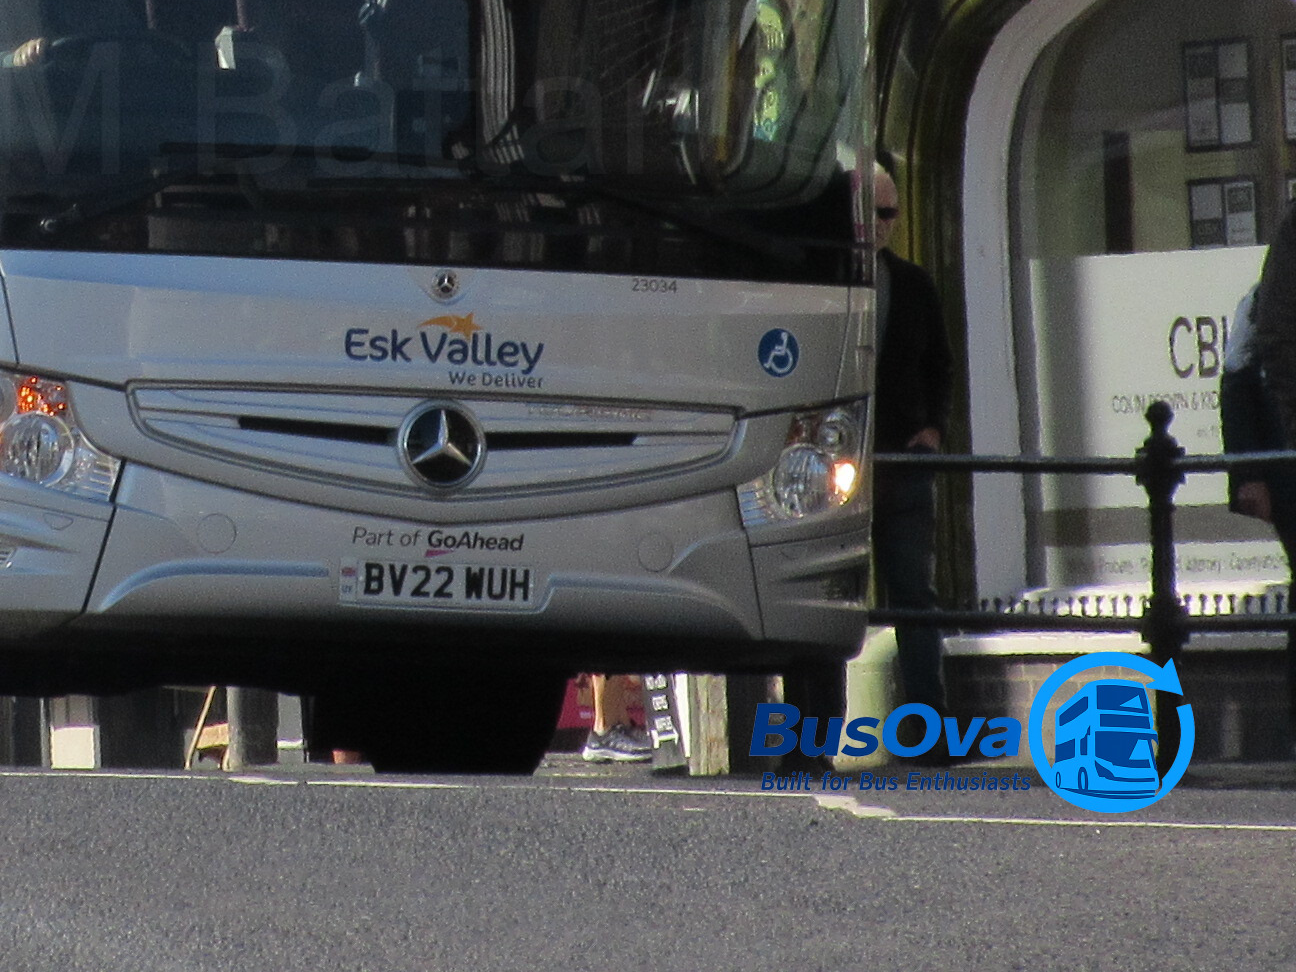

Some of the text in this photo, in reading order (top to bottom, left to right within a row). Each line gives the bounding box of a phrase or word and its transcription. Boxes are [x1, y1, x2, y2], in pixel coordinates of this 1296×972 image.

[631, 278, 677, 294] 23034
[344, 328, 545, 371] Esk Valley
[448, 371, 543, 389] We Deliver
[352, 527, 525, 552] Part of GoAhead
[363, 562, 530, 601] BV22 WUH
